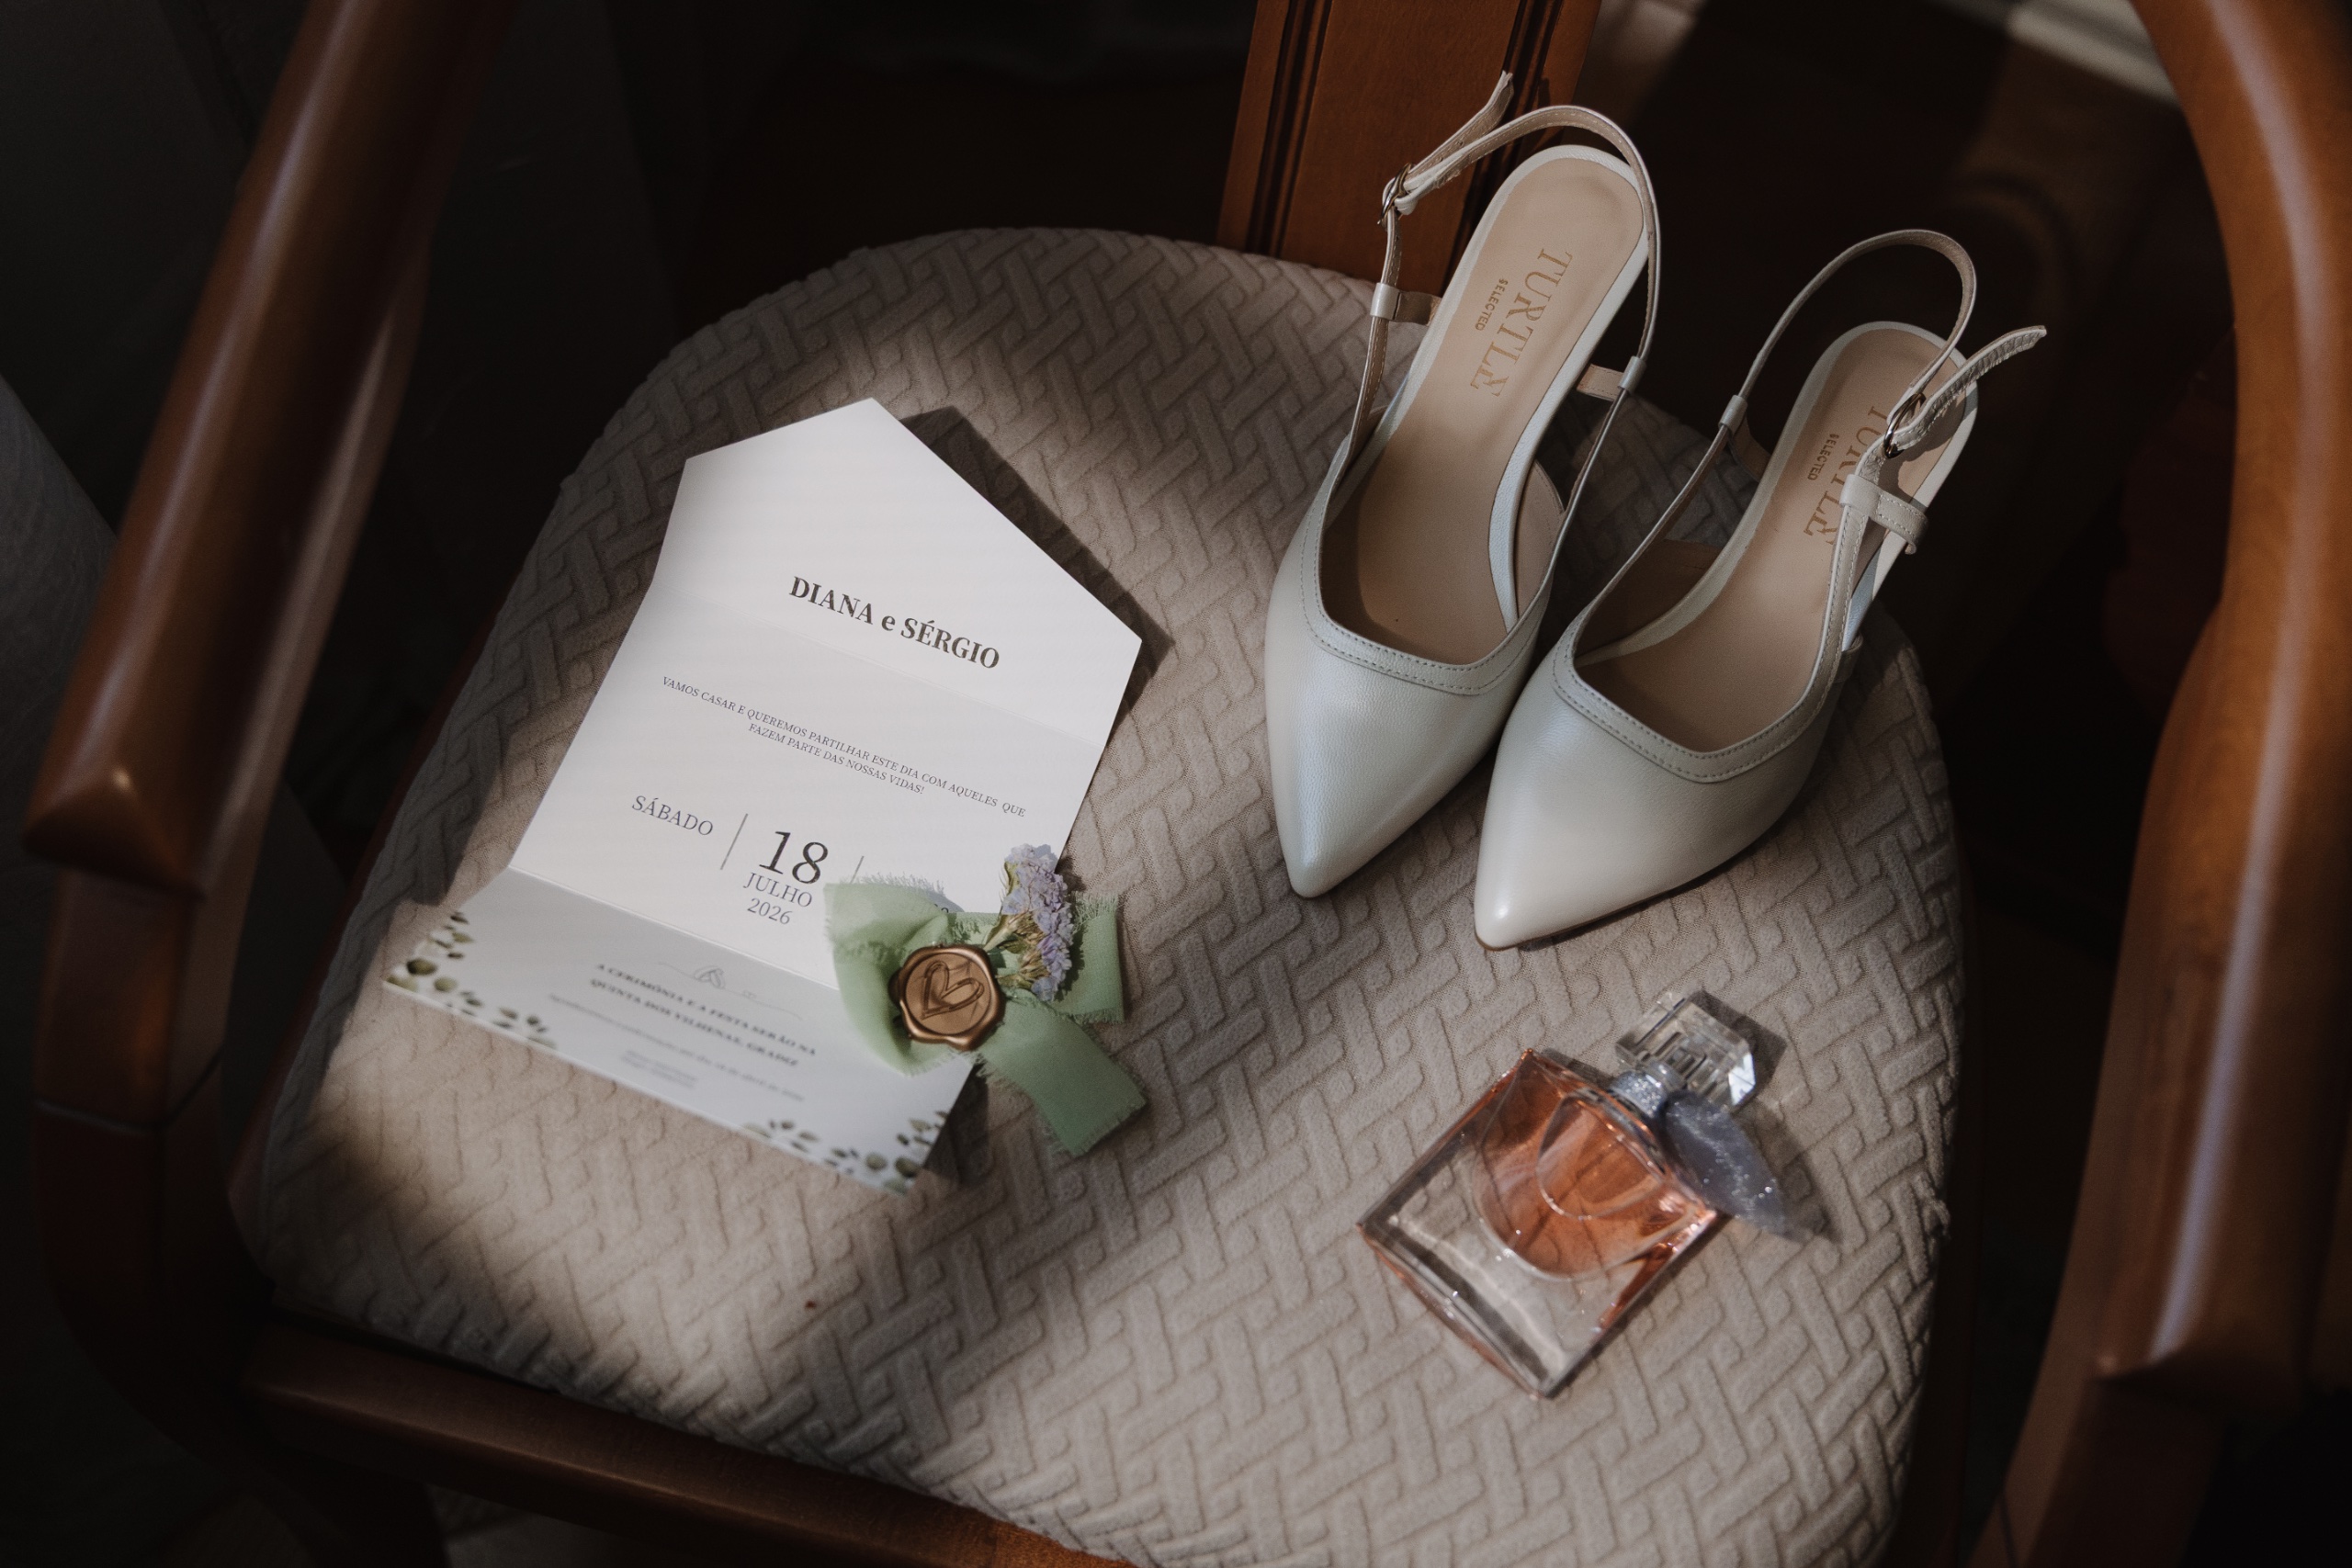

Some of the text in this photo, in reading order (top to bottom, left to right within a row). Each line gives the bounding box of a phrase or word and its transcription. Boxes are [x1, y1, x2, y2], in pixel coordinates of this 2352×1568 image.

[1470, 247, 1573, 398] TURTLE
[1475, 277, 1508, 332] SELECTED
[1806, 432, 1841, 481] SELECTED
[788, 576, 1000, 669] DIANA e SÉRGIO
[662, 676, 1026, 818] VAMOS CASAR E QUEREMOS PARTILHAR ESTE DIA COM AQUELES QUE
[748, 723, 925, 795] FAZEM PARTE DAS NOSSAS VIDAS!
[631, 795, 714, 836] SÁBADO
[759, 830, 829, 885] 18
[743, 872, 813, 908] JULHO
[747, 897, 793, 925] 2026
